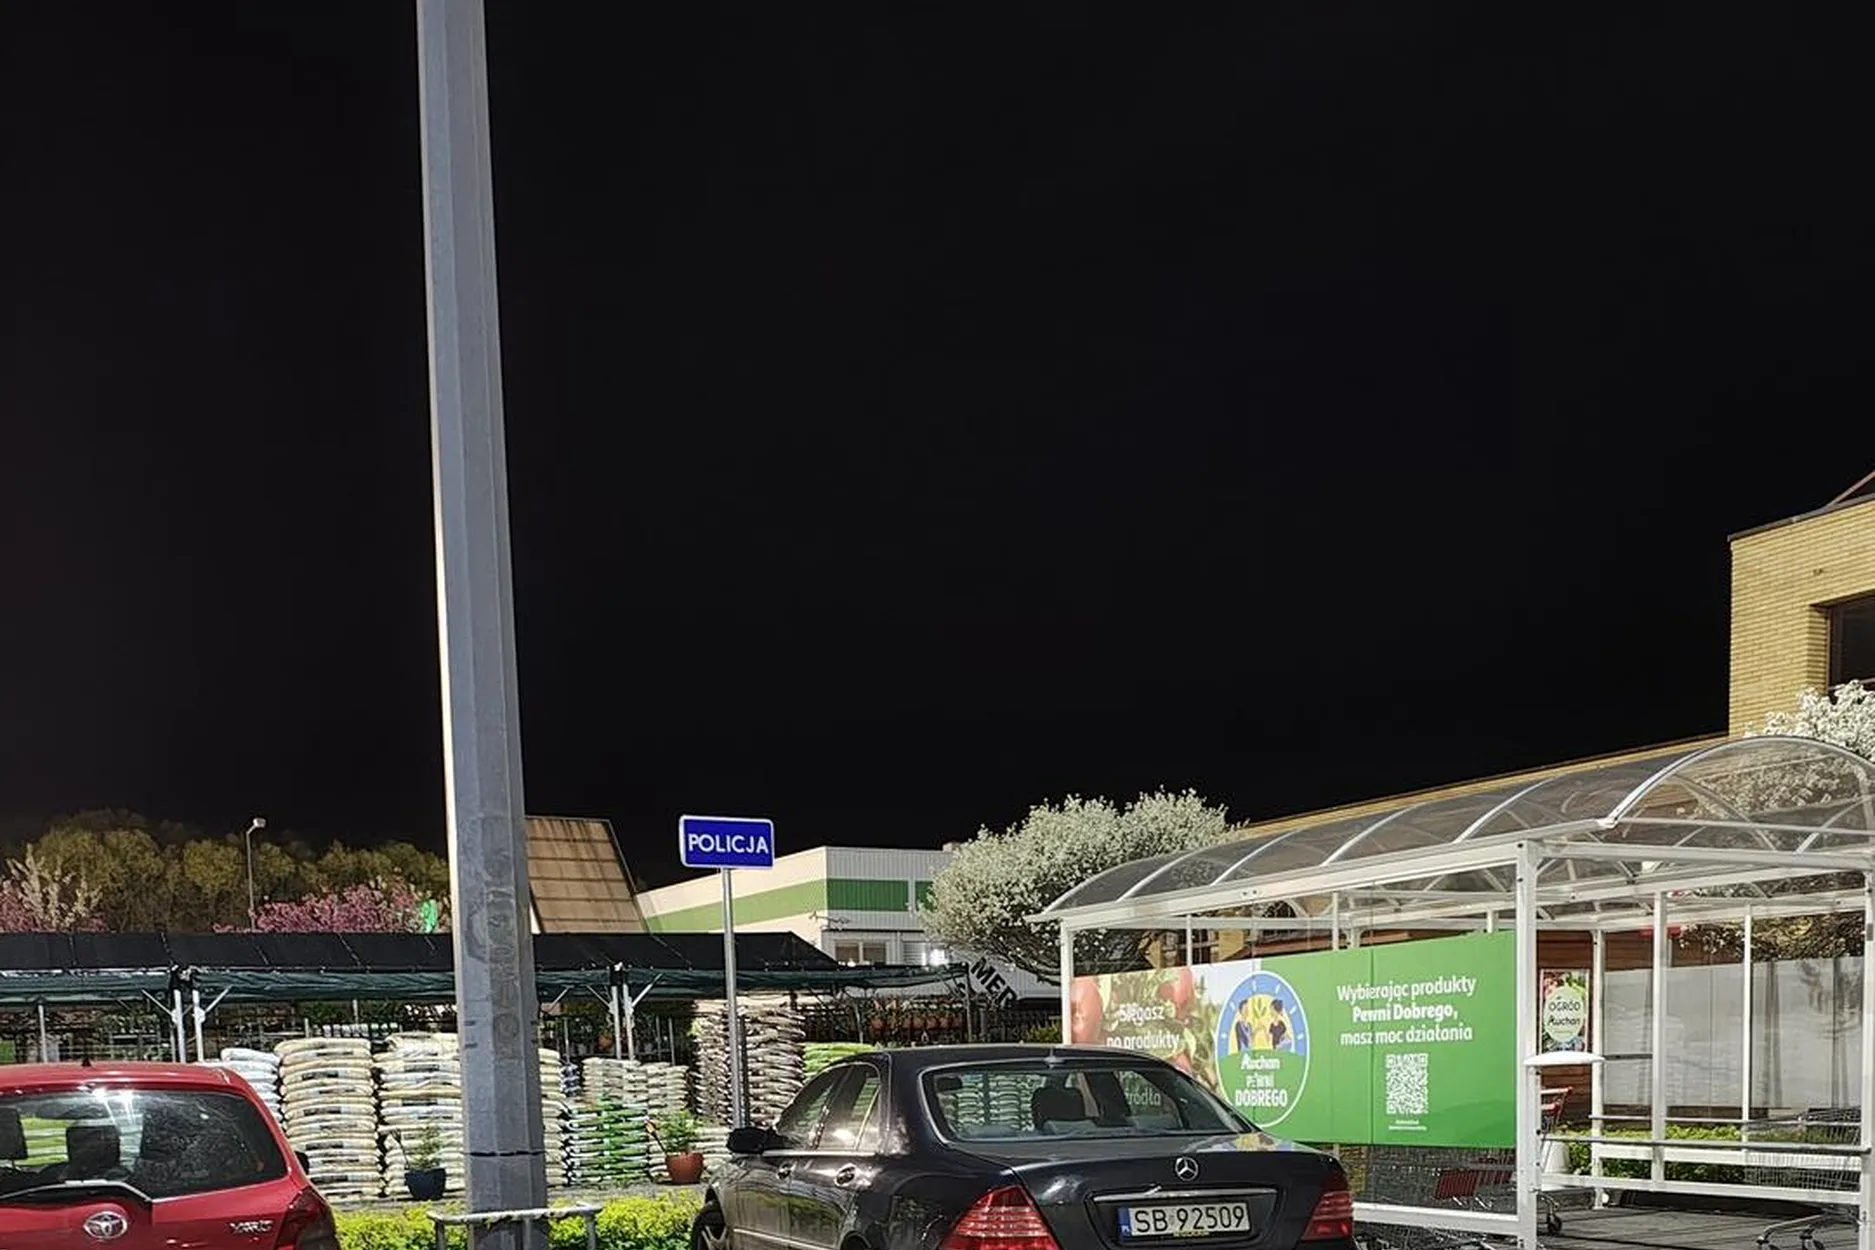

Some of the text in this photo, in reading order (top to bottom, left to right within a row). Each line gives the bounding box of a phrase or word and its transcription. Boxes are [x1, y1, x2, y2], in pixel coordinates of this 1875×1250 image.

[688, 833, 769, 854] POLICJA
[1337, 976, 1476, 1005] Wybierając produkty
[1352, 1001, 1458, 1023] Pewni Dobrego,
[1547, 1014, 1581, 1026] Auchan
[1124, 1030, 1180, 1050] produkty
[1340, 1022, 1473, 1046] masz moc działania
[1241, 1053, 1280, 1070] Auchan
[1235, 1089, 1288, 1107] DOBREGO
[1134, 1205, 1244, 1232] SB 92509
